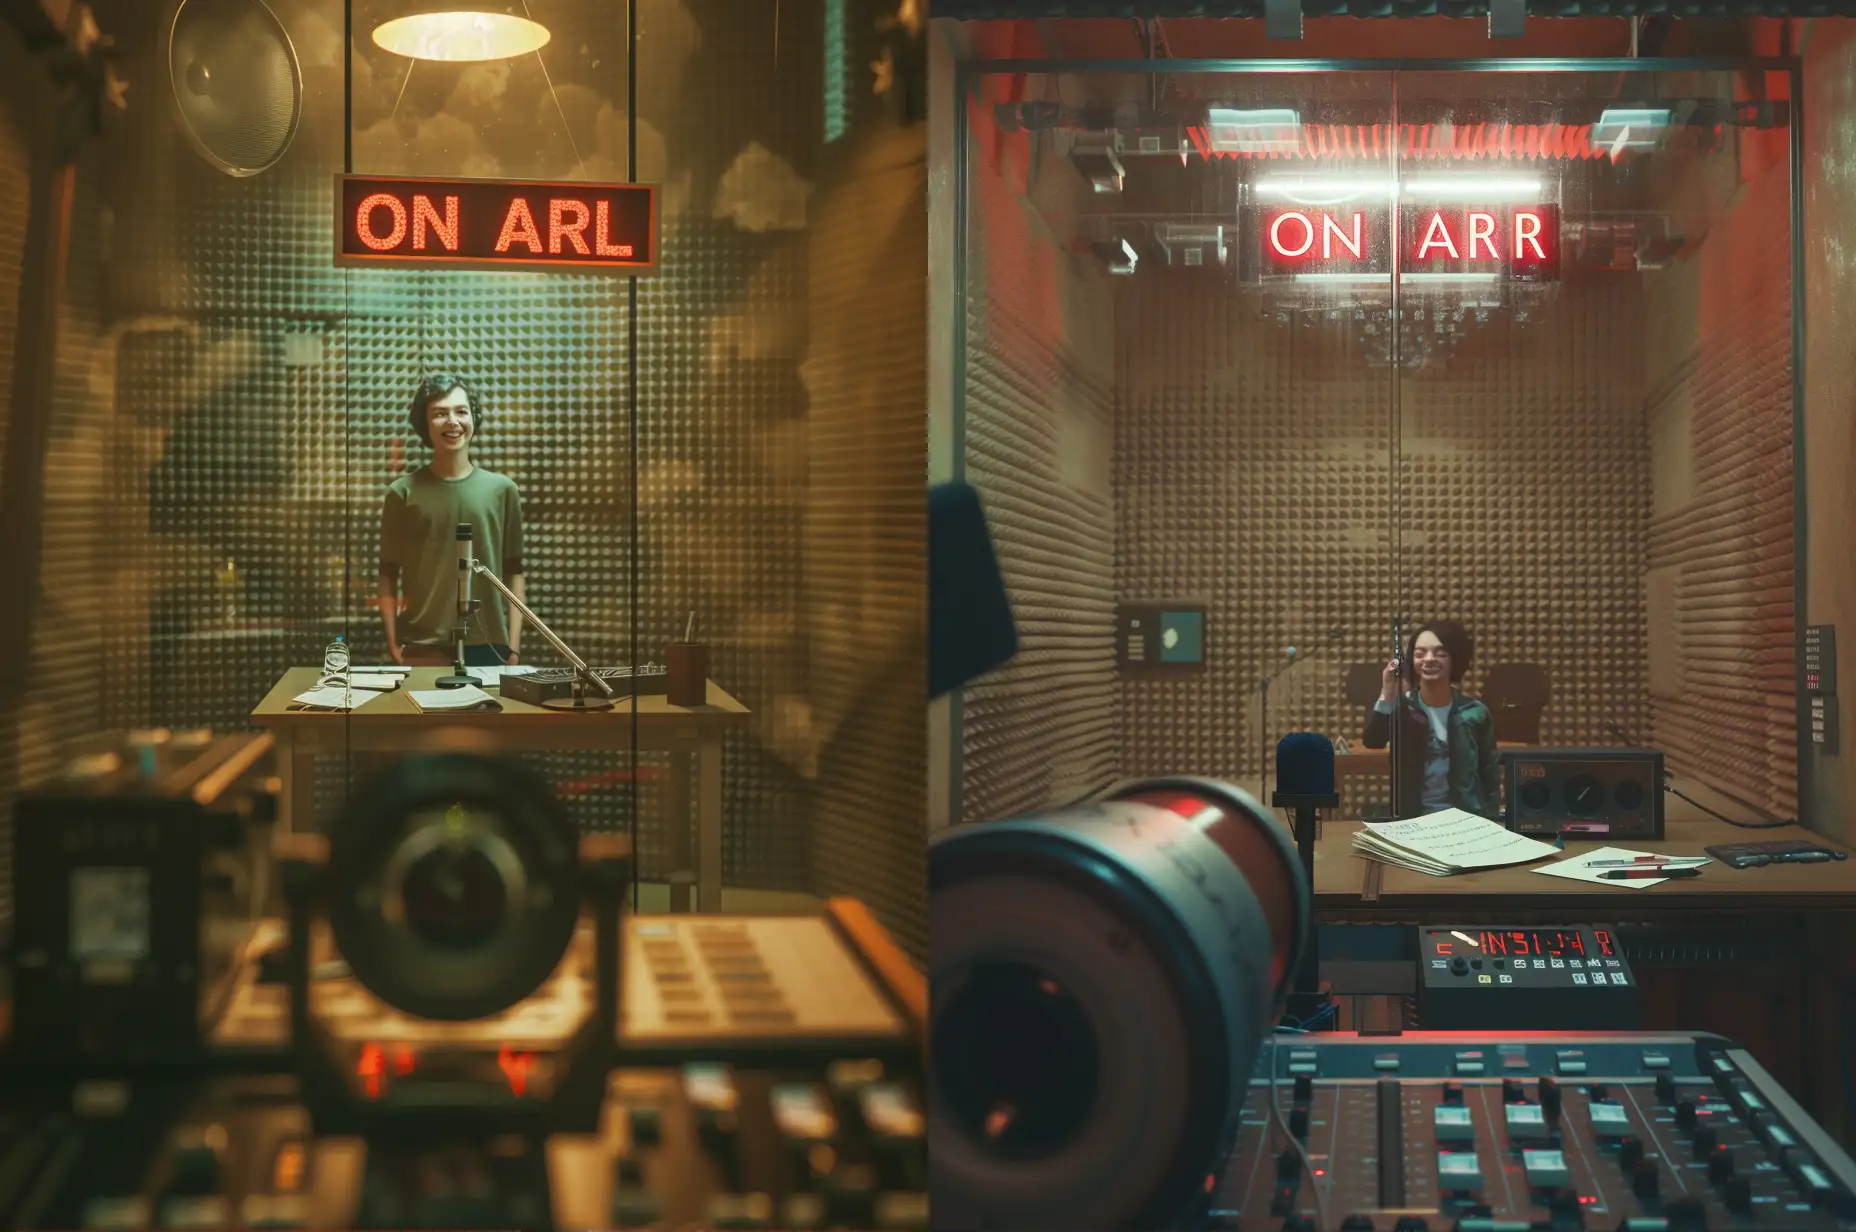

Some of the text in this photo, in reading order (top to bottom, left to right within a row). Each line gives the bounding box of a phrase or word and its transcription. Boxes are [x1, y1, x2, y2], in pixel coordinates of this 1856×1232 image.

[356, 193, 632, 257] ON ARL
[1270, 211, 1546, 260] ON ARR
